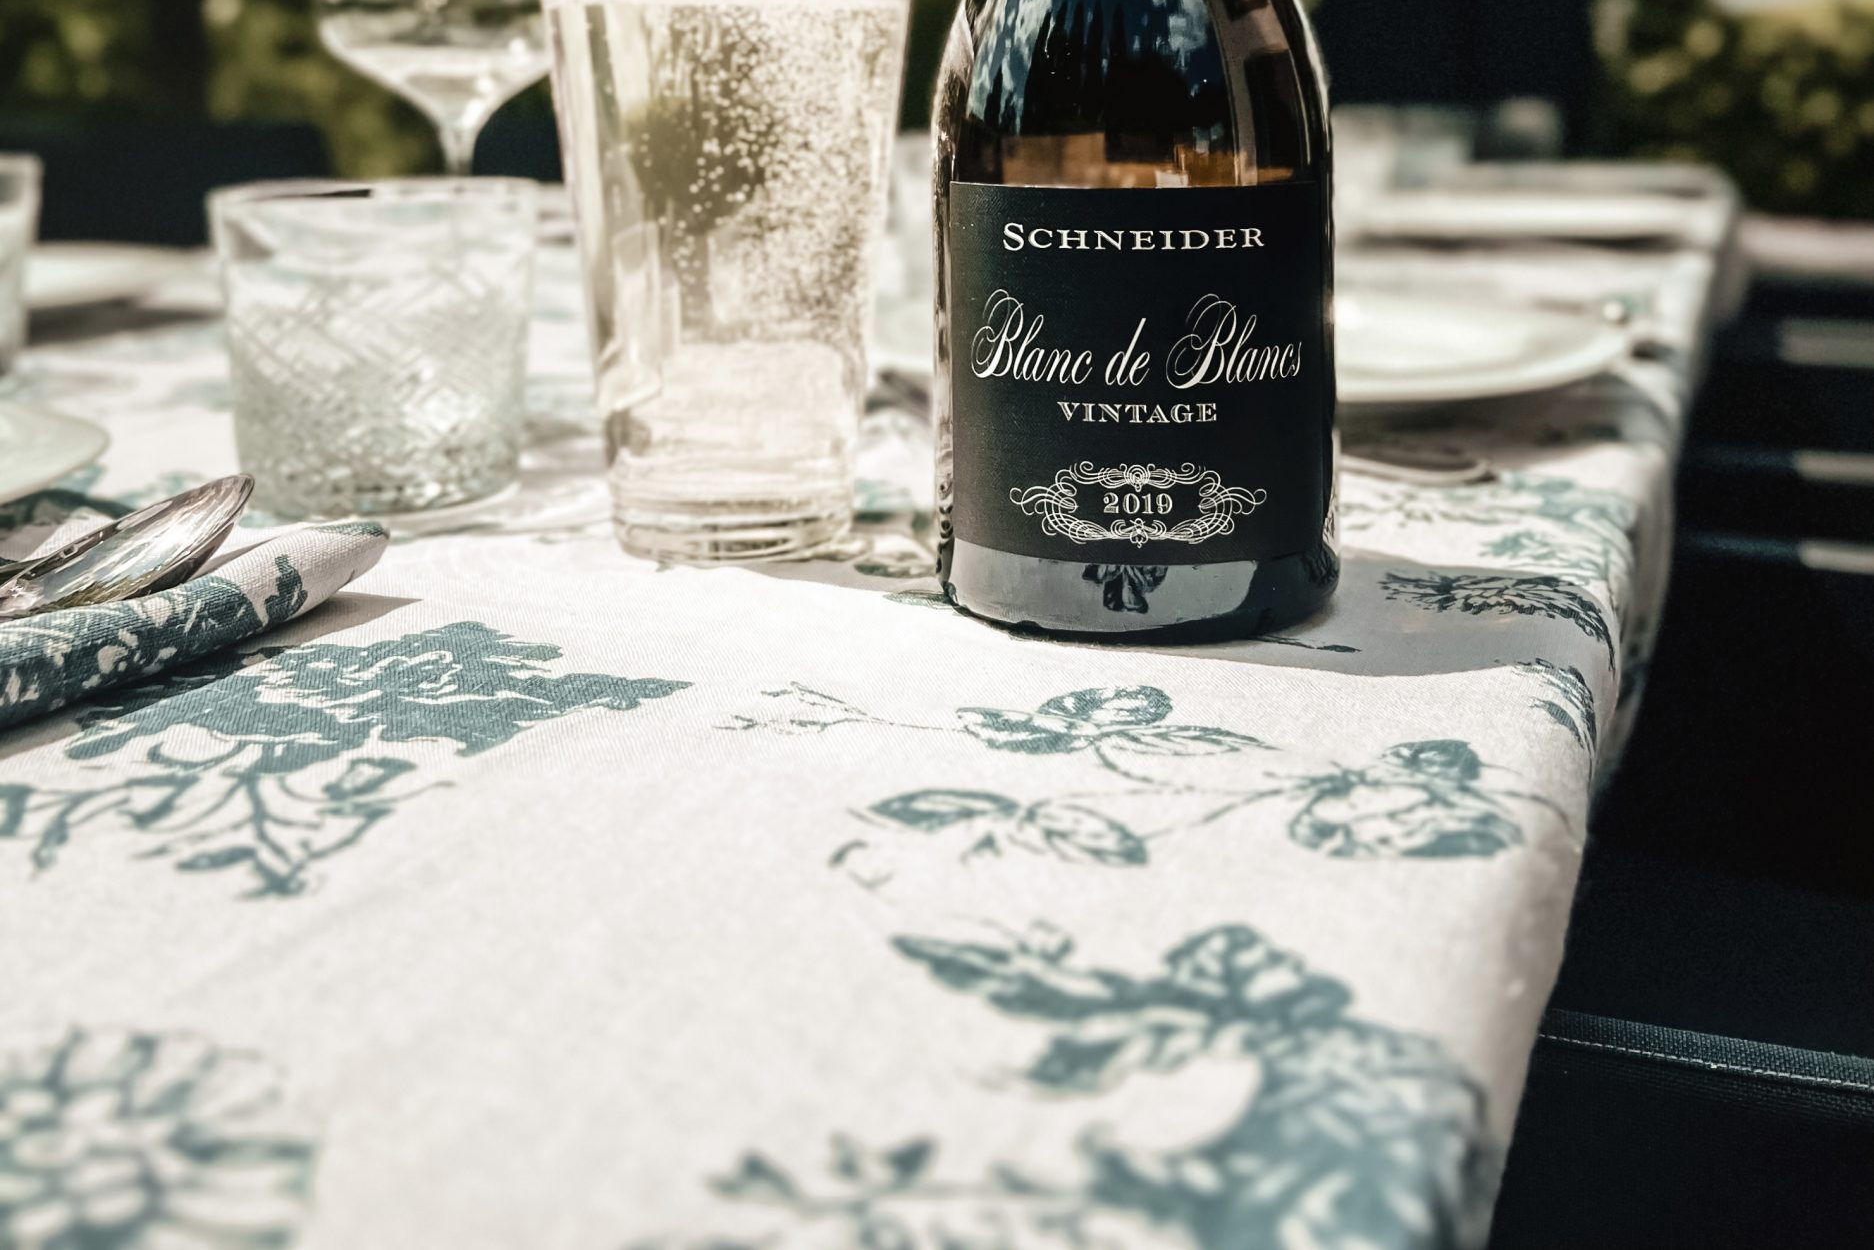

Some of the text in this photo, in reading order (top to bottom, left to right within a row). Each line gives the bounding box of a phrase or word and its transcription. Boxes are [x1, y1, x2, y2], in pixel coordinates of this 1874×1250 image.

[971, 288, 1302, 390] Blanc de Blancs
[1057, 401, 1217, 424] VINTAGE
[1102, 492, 1173, 515] 2019
